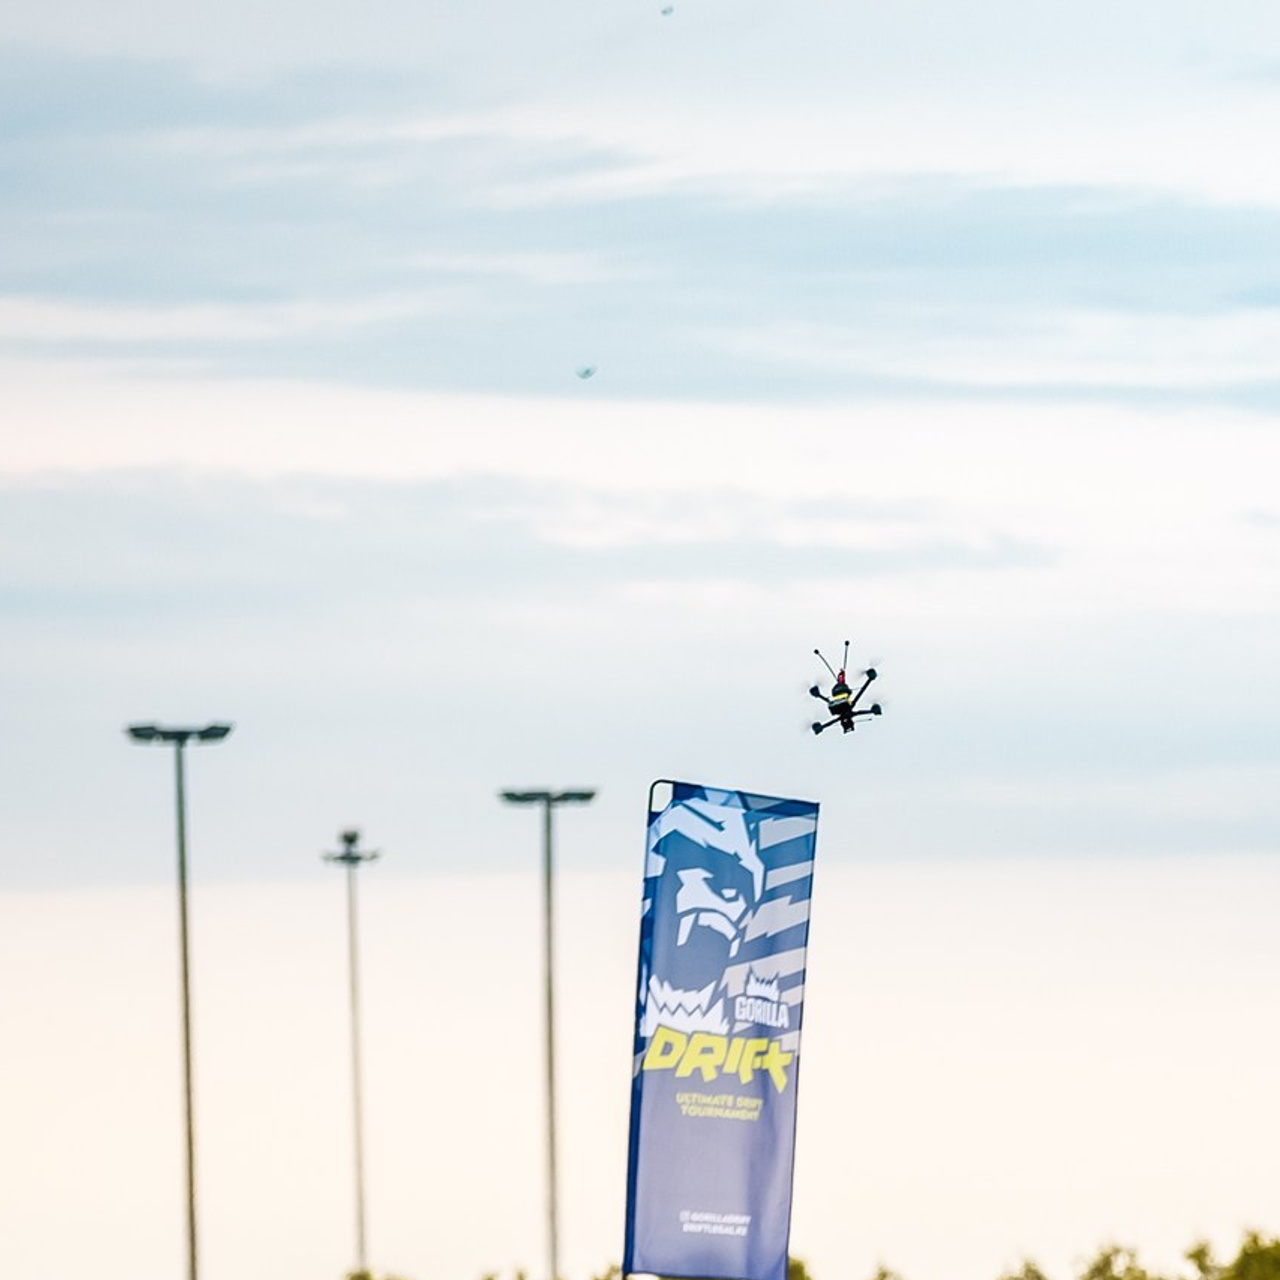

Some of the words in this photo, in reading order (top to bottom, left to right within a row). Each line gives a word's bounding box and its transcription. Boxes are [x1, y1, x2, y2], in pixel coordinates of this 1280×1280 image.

[735, 996, 789, 1029] GORILLA
[643, 1026, 792, 1093] DRIFT
[676, 1092, 734, 1107] ULTIMATE
[681, 1104, 760, 1121] TOURNAMENT
